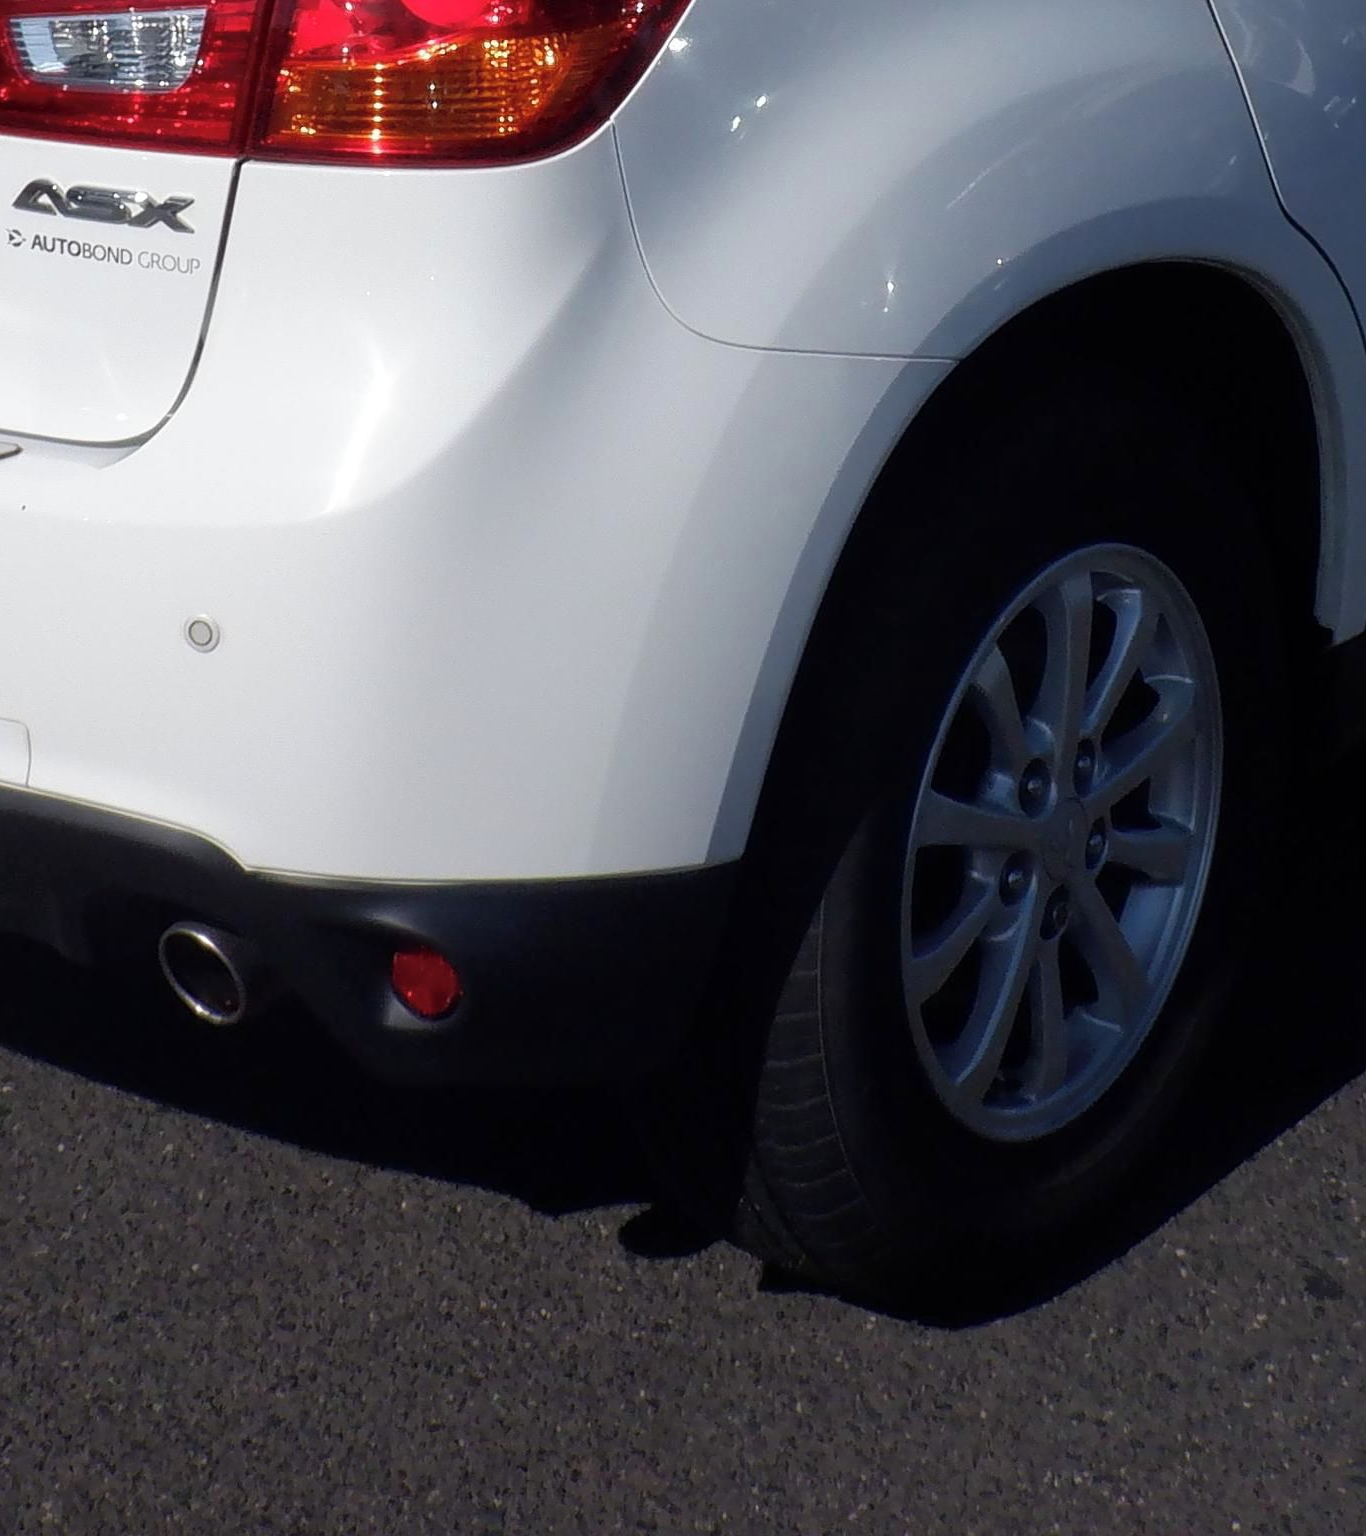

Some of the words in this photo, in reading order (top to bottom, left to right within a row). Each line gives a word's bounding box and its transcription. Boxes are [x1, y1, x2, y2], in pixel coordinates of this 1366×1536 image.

[11, 178, 196, 234] ASX
[30, 233, 133, 265] AUTOBOND
[138, 250, 201, 274] GROUP
